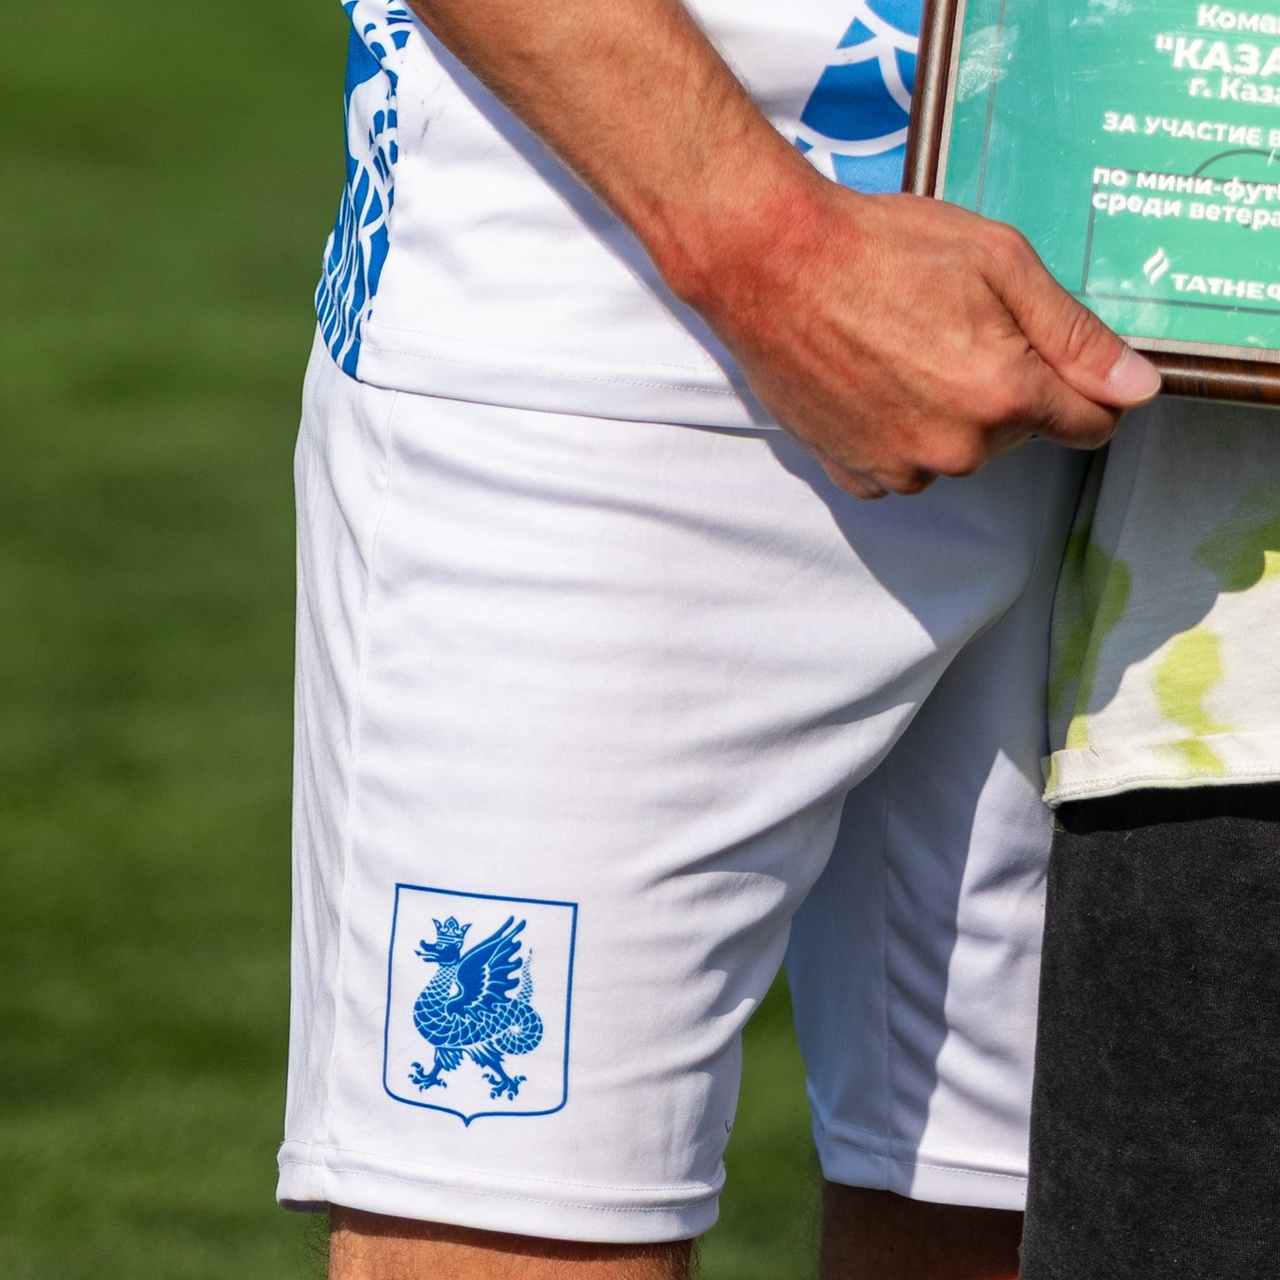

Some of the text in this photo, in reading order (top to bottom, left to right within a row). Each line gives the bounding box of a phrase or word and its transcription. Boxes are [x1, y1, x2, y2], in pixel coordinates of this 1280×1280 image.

[1188, 78, 1212, 99] г.
[1102, 111, 1138, 134] ЗА
[1144, 117, 1261, 147] УЧАСТИЕ
[1092, 166, 1129, 187] по
[1092, 192, 1181, 219] среди
